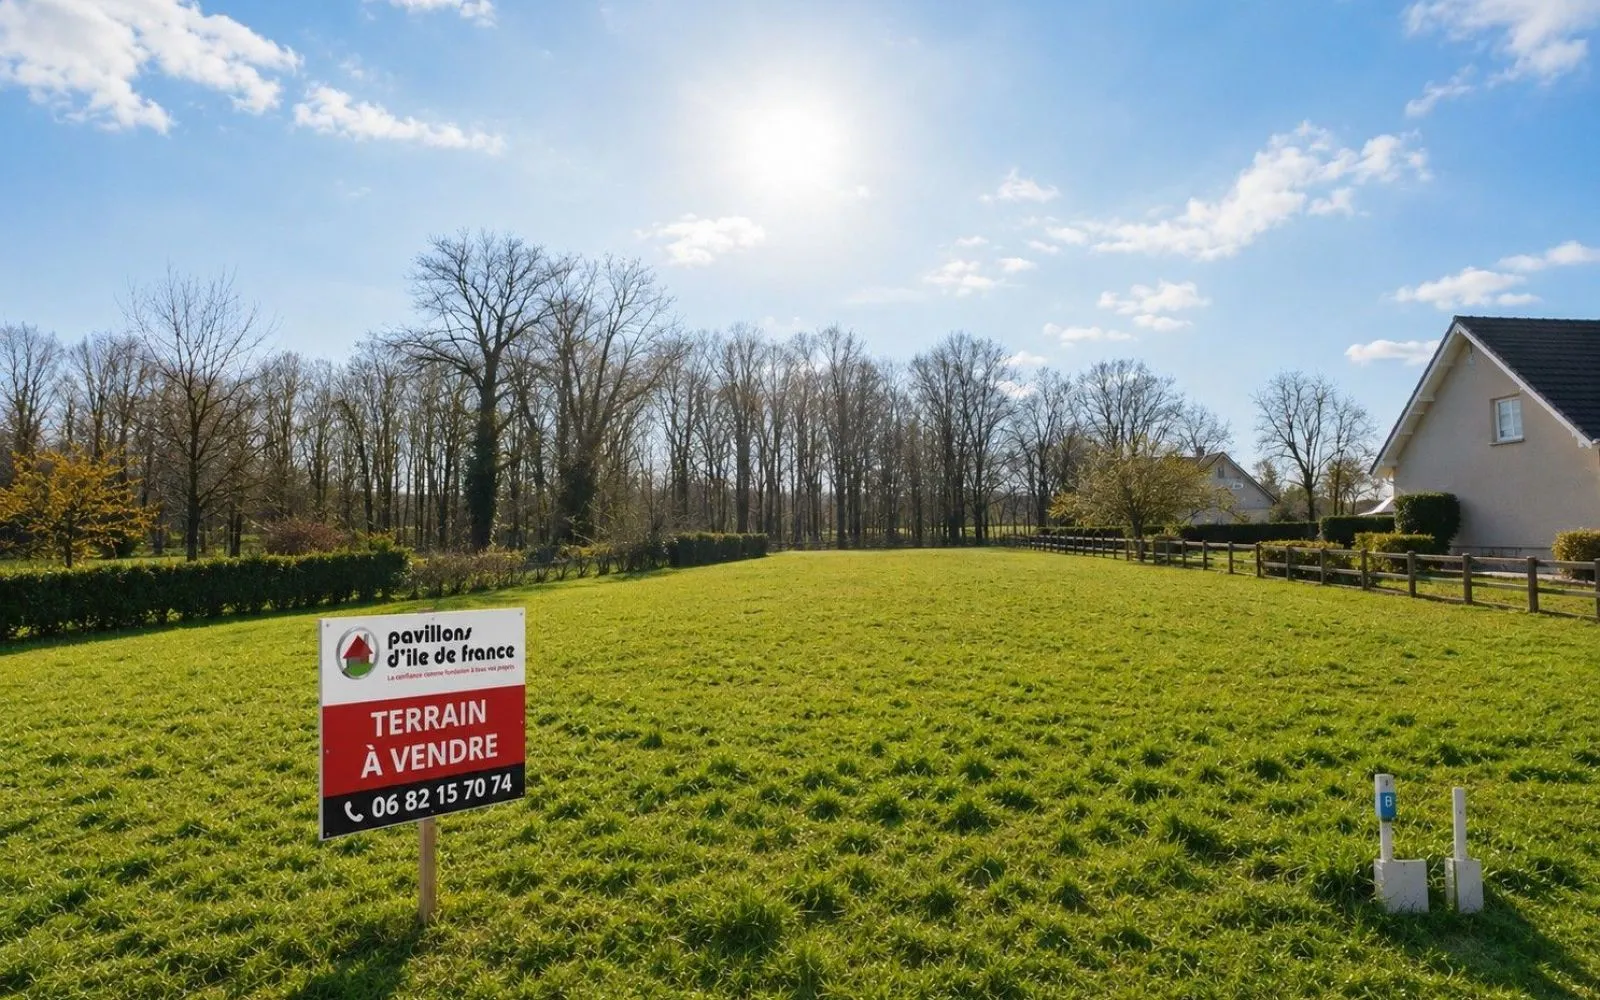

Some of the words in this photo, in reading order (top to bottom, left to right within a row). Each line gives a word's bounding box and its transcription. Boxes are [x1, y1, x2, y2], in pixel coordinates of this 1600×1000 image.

[387, 625, 472, 650] pavillons
[434, 646, 456, 665] de
[461, 645, 515, 662] france
[370, 699, 486, 737] TERRAIN
[360, 744, 383, 779] À
[389, 733, 498, 774] VENDRE
[371, 794, 399, 818] 06
[405, 788, 430, 811] 82
[436, 783, 458, 805] 15
[464, 778, 486, 800] 70
[491, 773, 512, 795] 74
